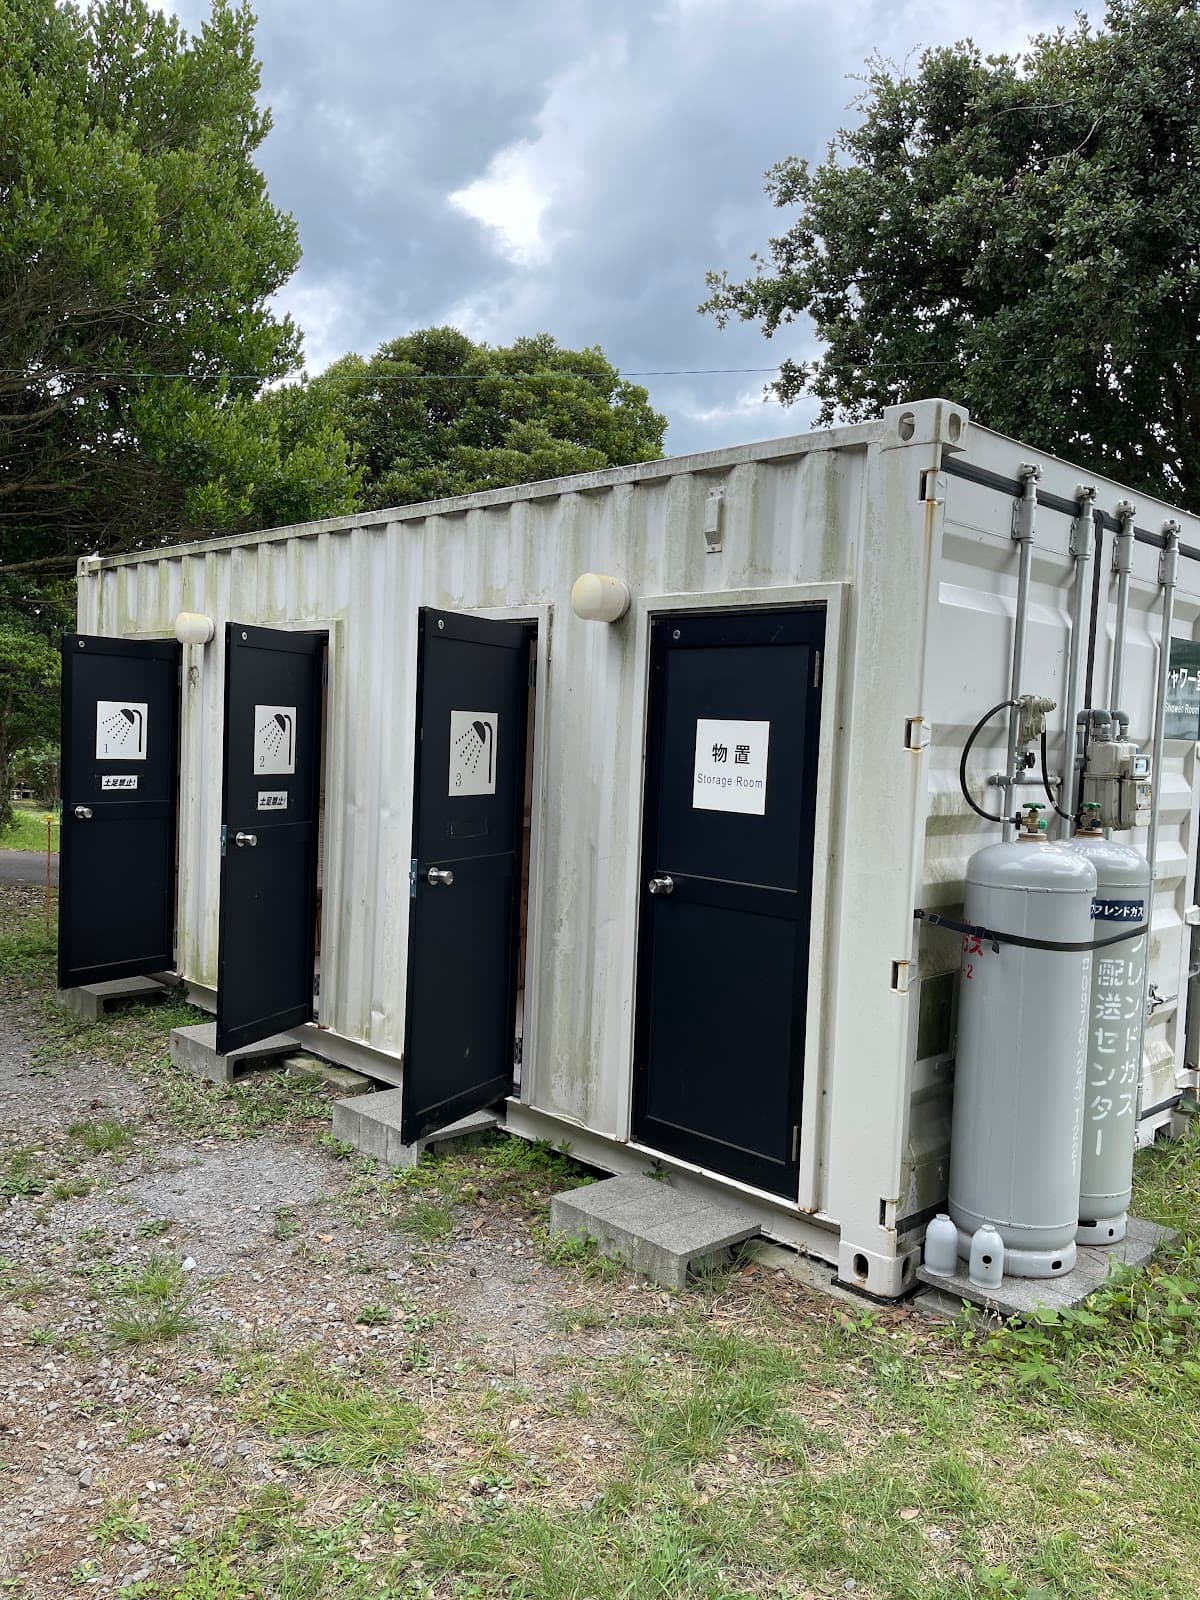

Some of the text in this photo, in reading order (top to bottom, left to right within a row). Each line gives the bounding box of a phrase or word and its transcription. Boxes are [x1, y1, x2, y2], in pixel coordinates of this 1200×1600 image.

[1167, 667, 1200, 691] ャワー
[104, 743, 109, 753] 1
[712, 743, 750, 764] 物置
[260, 755, 265, 767] 2
[455, 772, 462, 787] 3
[697, 772, 763, 788] Storage Room
[1090, 959, 1125, 1156] 配送センター
